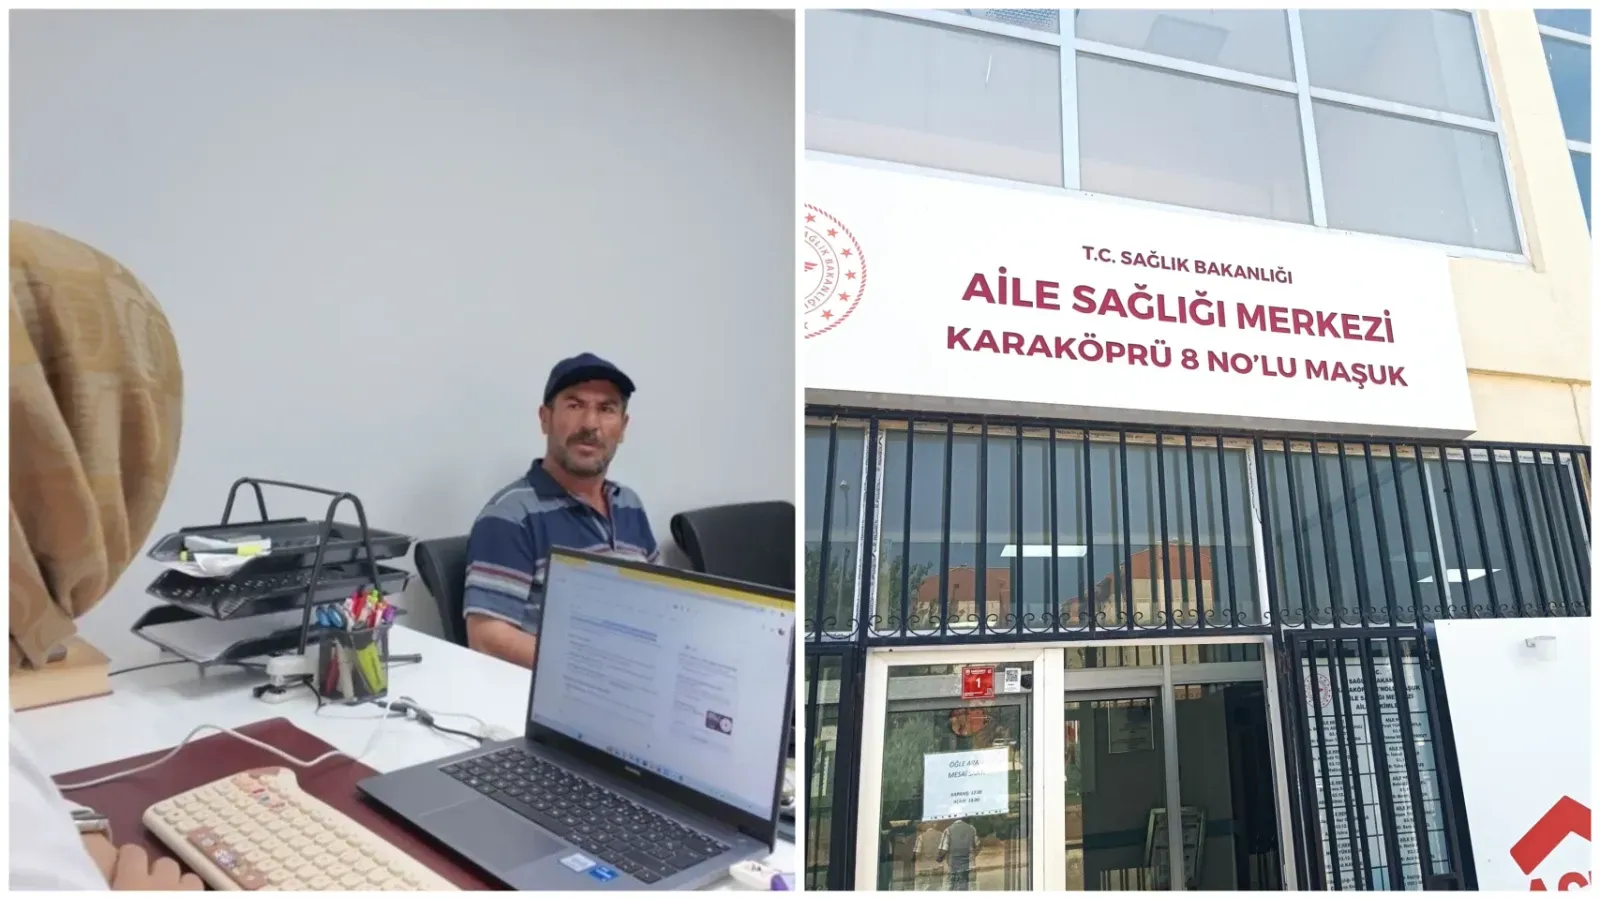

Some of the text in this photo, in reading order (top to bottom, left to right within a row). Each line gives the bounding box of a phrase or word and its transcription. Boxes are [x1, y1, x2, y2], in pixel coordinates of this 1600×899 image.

[1082, 246, 1293, 285] T.C. SAĞLIK BAKANLIĞI
[961, 266, 1395, 344] AİLE SAĞLIĞI MERKEZİ
[946, 325, 1409, 390] KARAKÖPRÜ 8 NO’LU MAŞUK
[975, 677, 981, 688] 1
